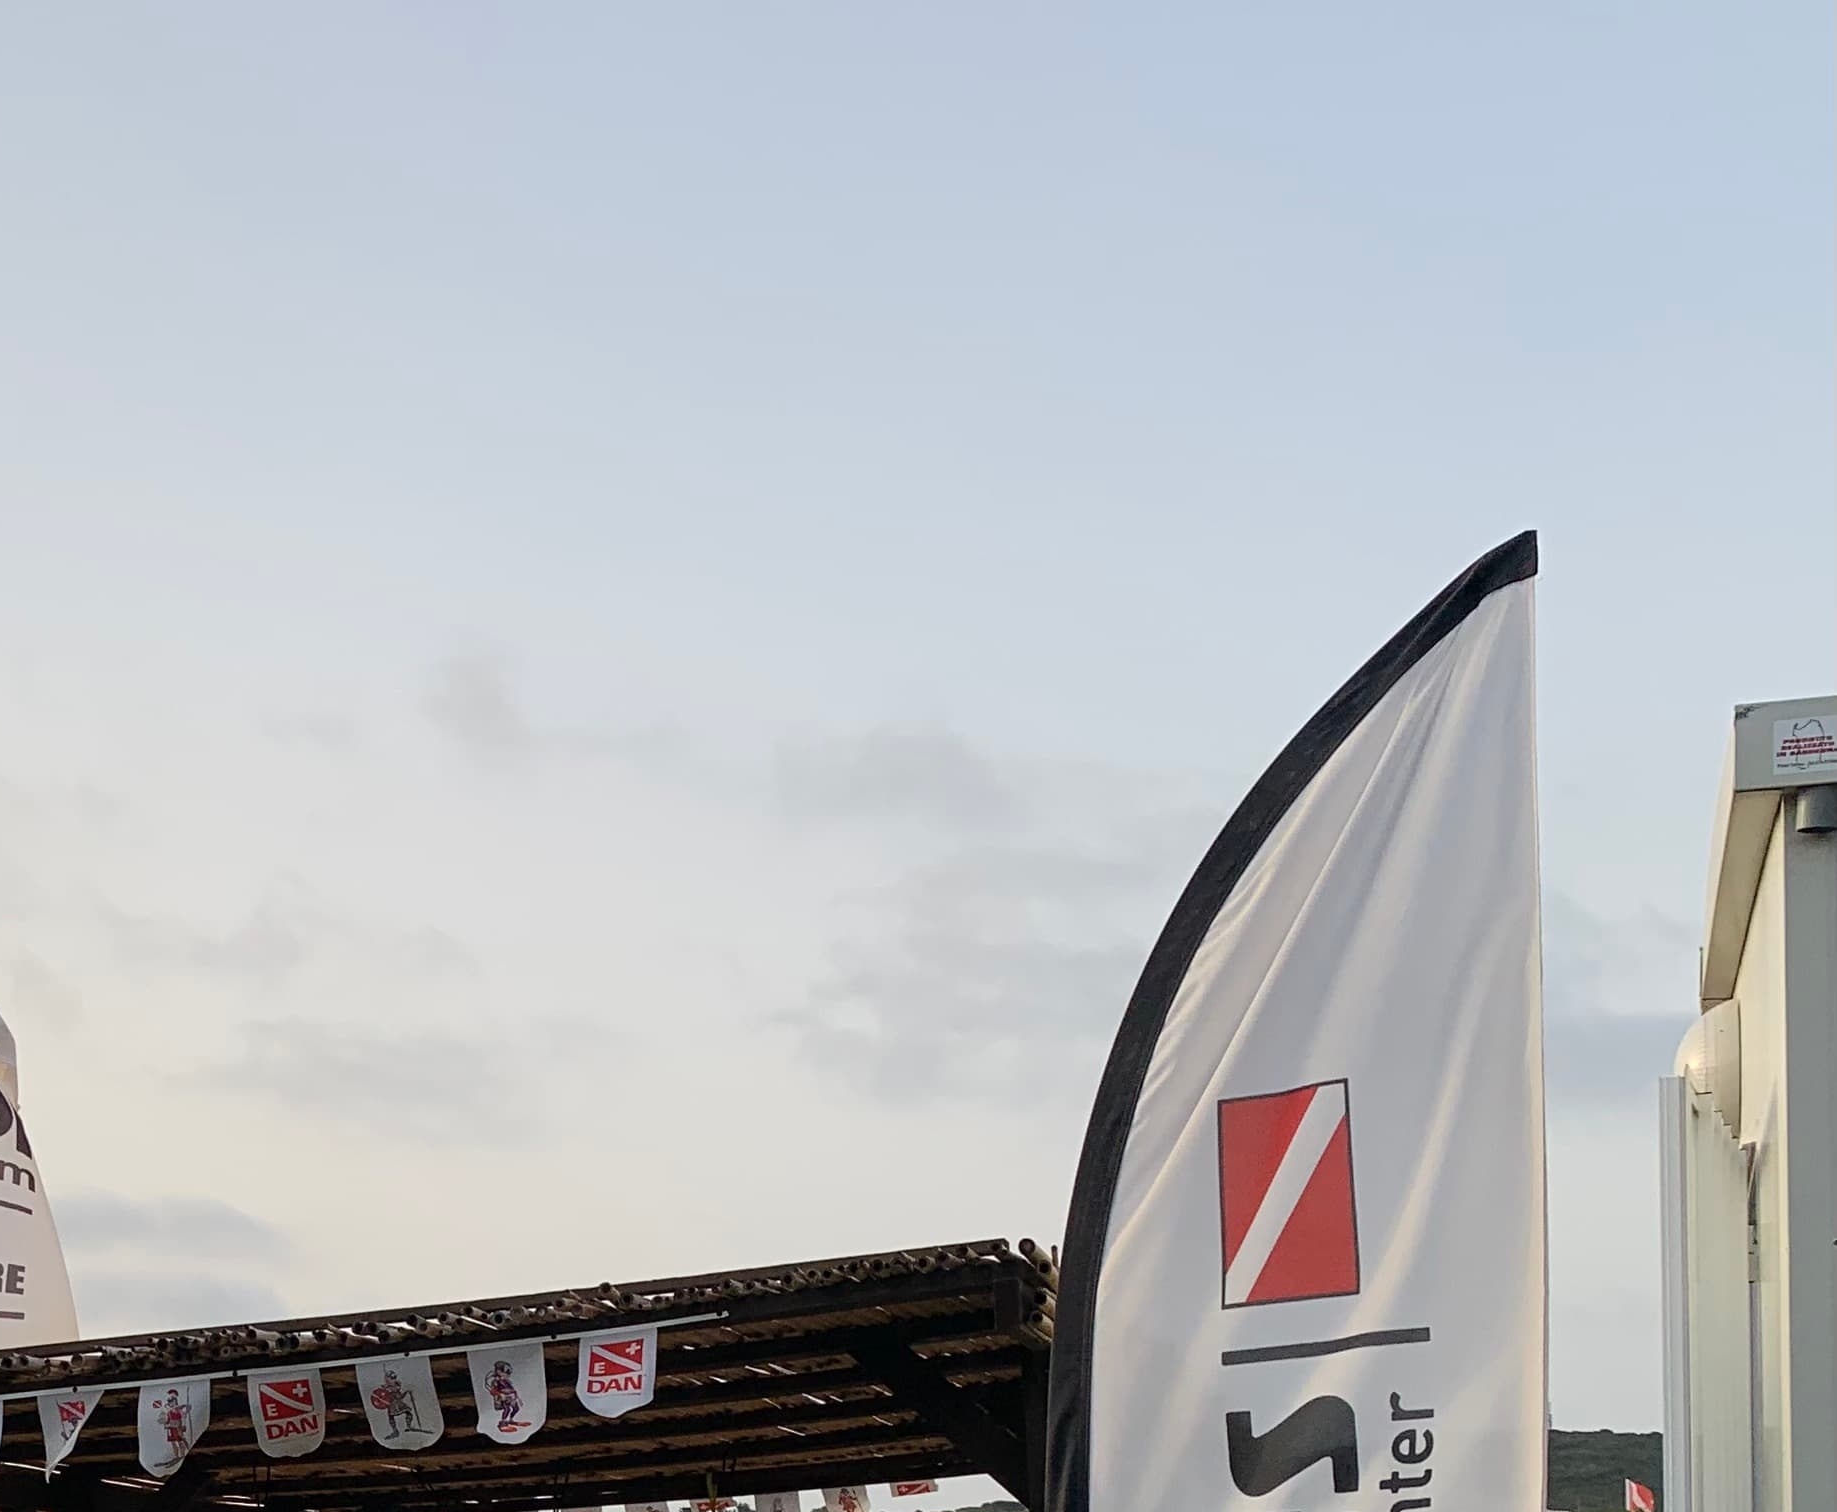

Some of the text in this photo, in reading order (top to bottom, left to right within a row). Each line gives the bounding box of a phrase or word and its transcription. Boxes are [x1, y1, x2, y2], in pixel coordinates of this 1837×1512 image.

[594, 1362, 606, 1374] E
[586, 1374, 643, 1394] DAN
[266, 1403, 279, 1417] E
[265, 1414, 319, 1440] DAN
